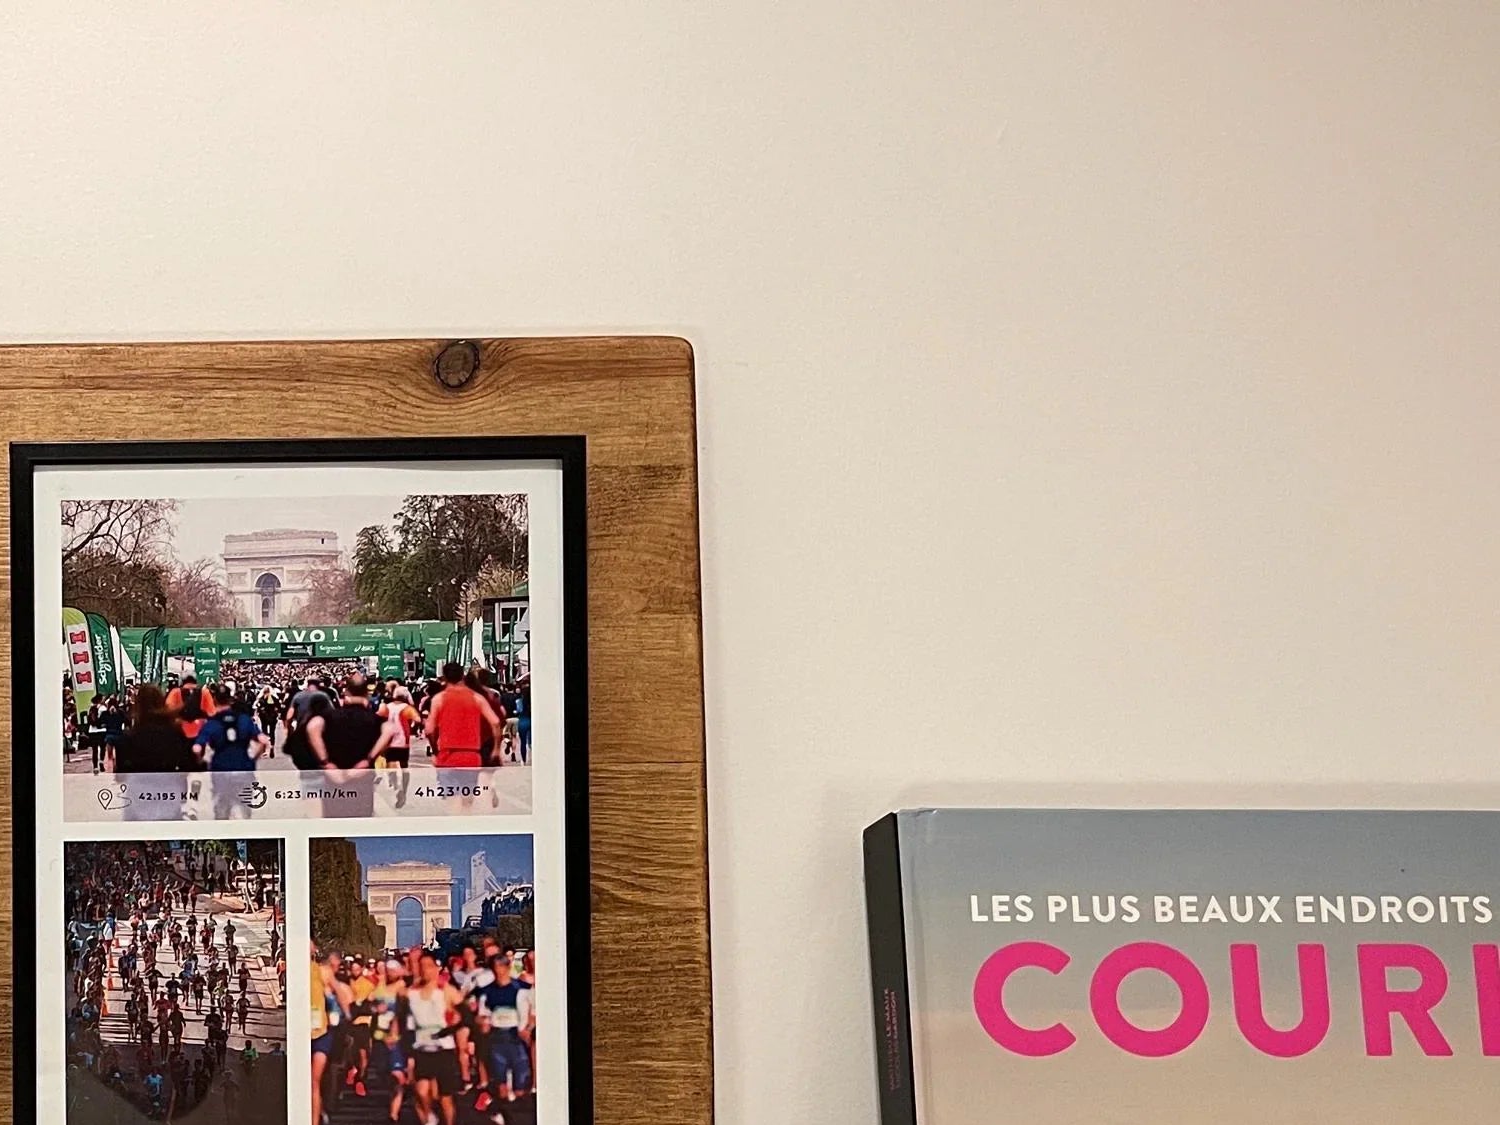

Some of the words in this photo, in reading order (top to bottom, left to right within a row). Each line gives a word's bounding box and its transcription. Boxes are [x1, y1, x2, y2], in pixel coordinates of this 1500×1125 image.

[241, 629, 326, 644] BRAVO
[138, 792, 176, 801] 42.195
[180, 792, 199, 801] KM
[274, 790, 301, 799] 6:23
[970, 894, 1034, 922] LES
[1047, 895, 1141, 923] PLUS
[1153, 895, 1283, 923] BEAUX
[1295, 895, 1493, 924] ENDROITS
